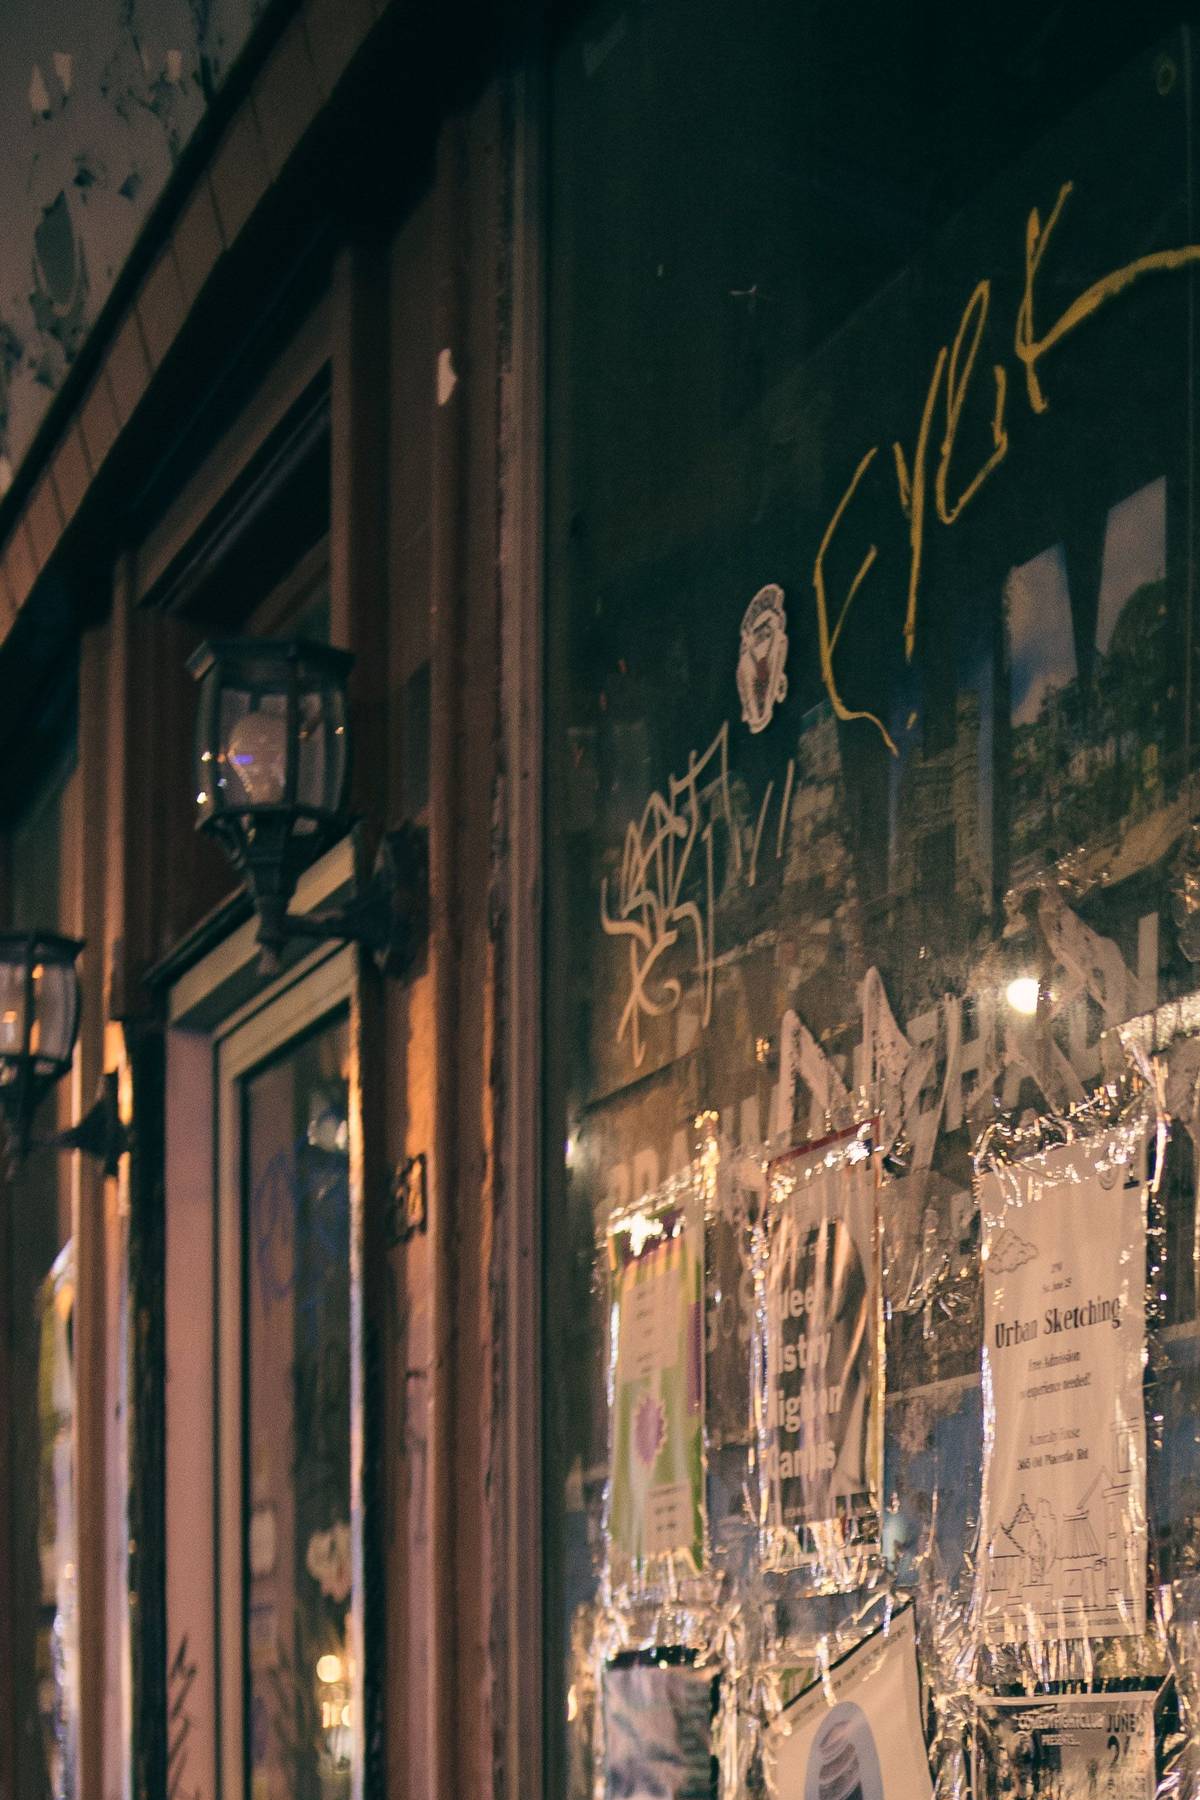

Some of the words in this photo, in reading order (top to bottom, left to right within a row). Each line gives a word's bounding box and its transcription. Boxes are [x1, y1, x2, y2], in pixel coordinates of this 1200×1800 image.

[995, 1317, 1038, 1349] Urban
[1043, 1296, 1121, 1336] Sketching
[1105, 1712, 1137, 1733] JUNE
